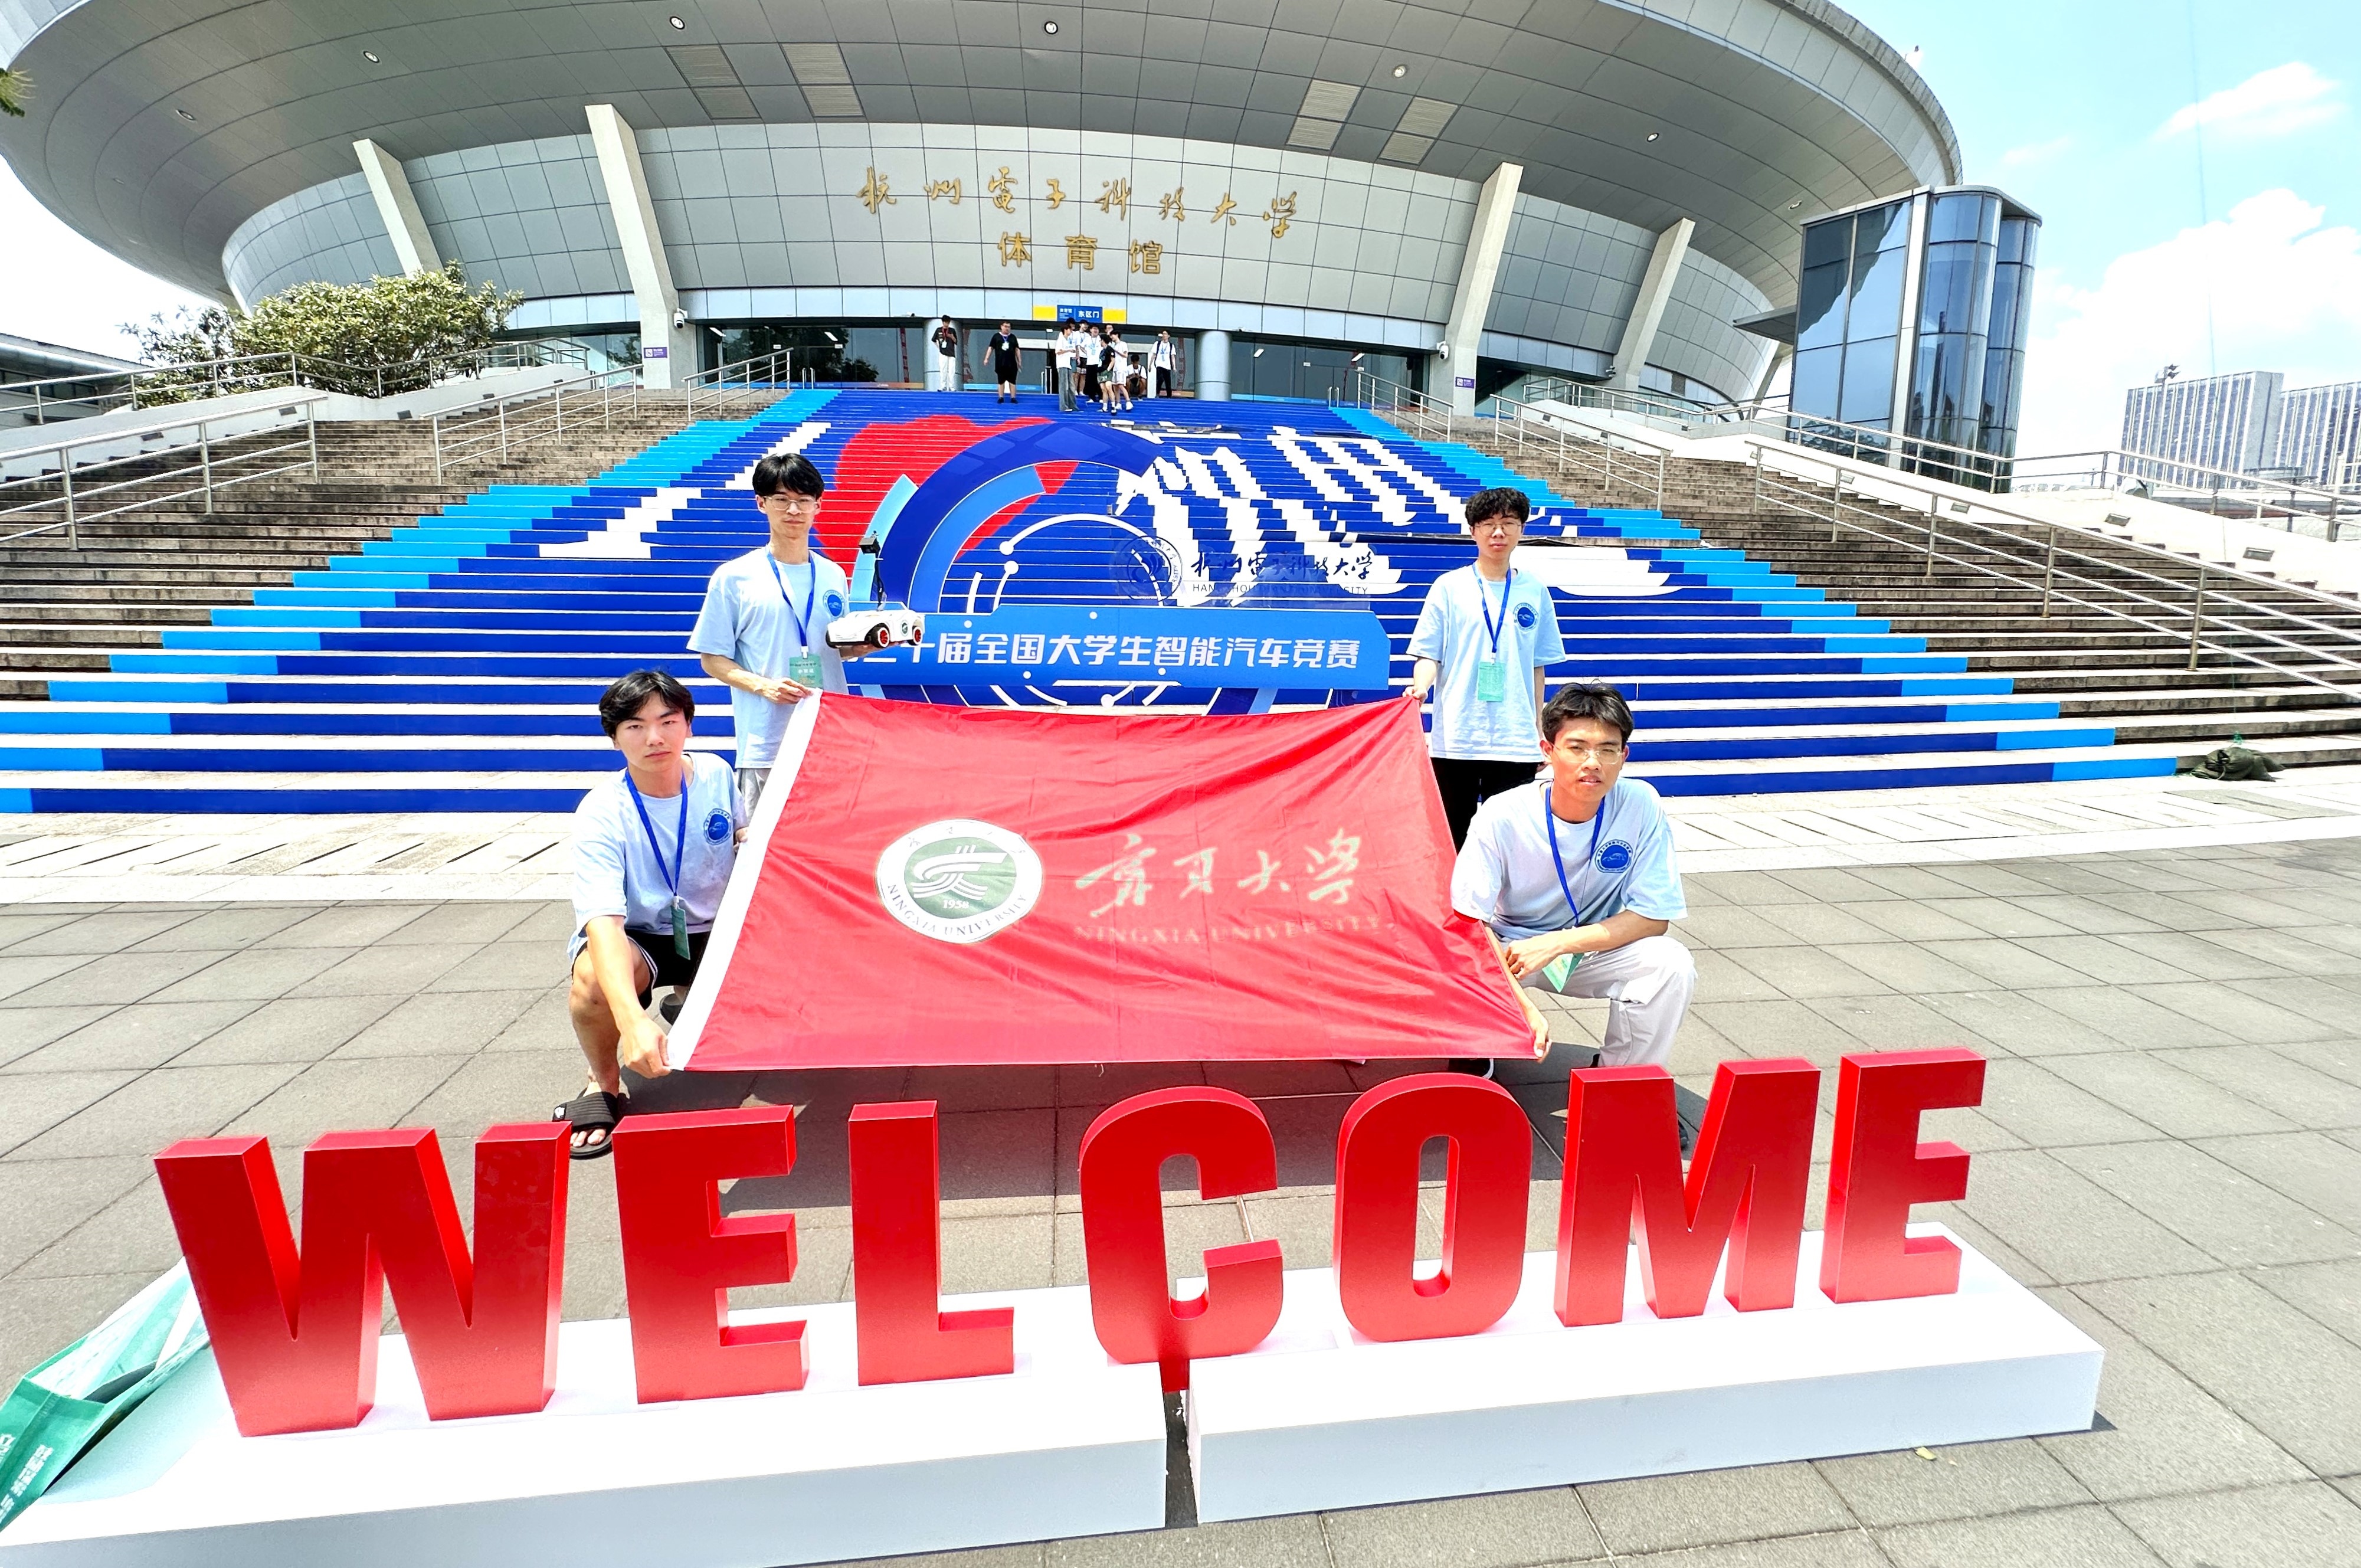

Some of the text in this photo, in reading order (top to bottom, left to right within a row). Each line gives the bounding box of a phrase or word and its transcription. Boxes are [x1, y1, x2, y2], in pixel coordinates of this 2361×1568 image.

[998, 231, 1163, 274] 体育馆
[842, 633, 1360, 669] 二十届全国大学生智能汽车竞赛
[887, 884, 1027, 936] NINGXIA UNIVERSITY
[943, 899, 970, 909] 1958
[1073, 915, 1381, 944] NINGXIA UNIVERSITY
[155, 1047, 1987, 1438] WELCOME
